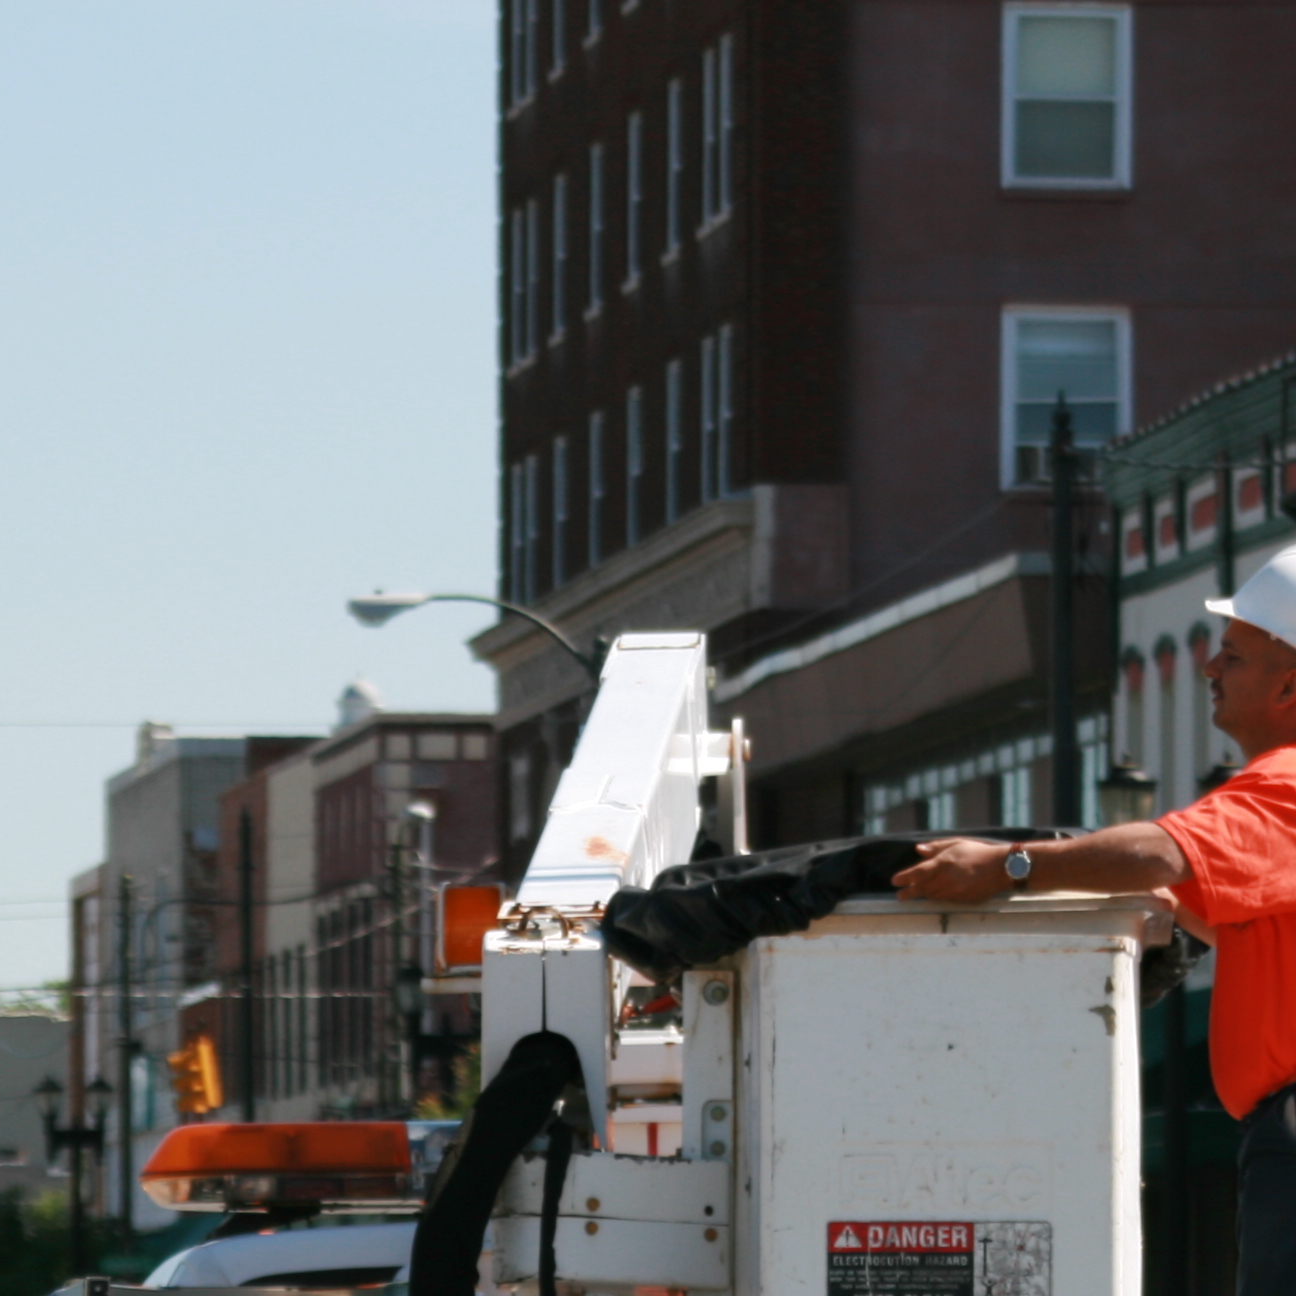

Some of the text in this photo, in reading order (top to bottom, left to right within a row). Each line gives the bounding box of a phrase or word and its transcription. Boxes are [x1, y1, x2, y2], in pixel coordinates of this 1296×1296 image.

[868, 1225, 968, 1248] DANGER
[832, 1255, 968, 1266] ELECTROCUTION HAZARD
